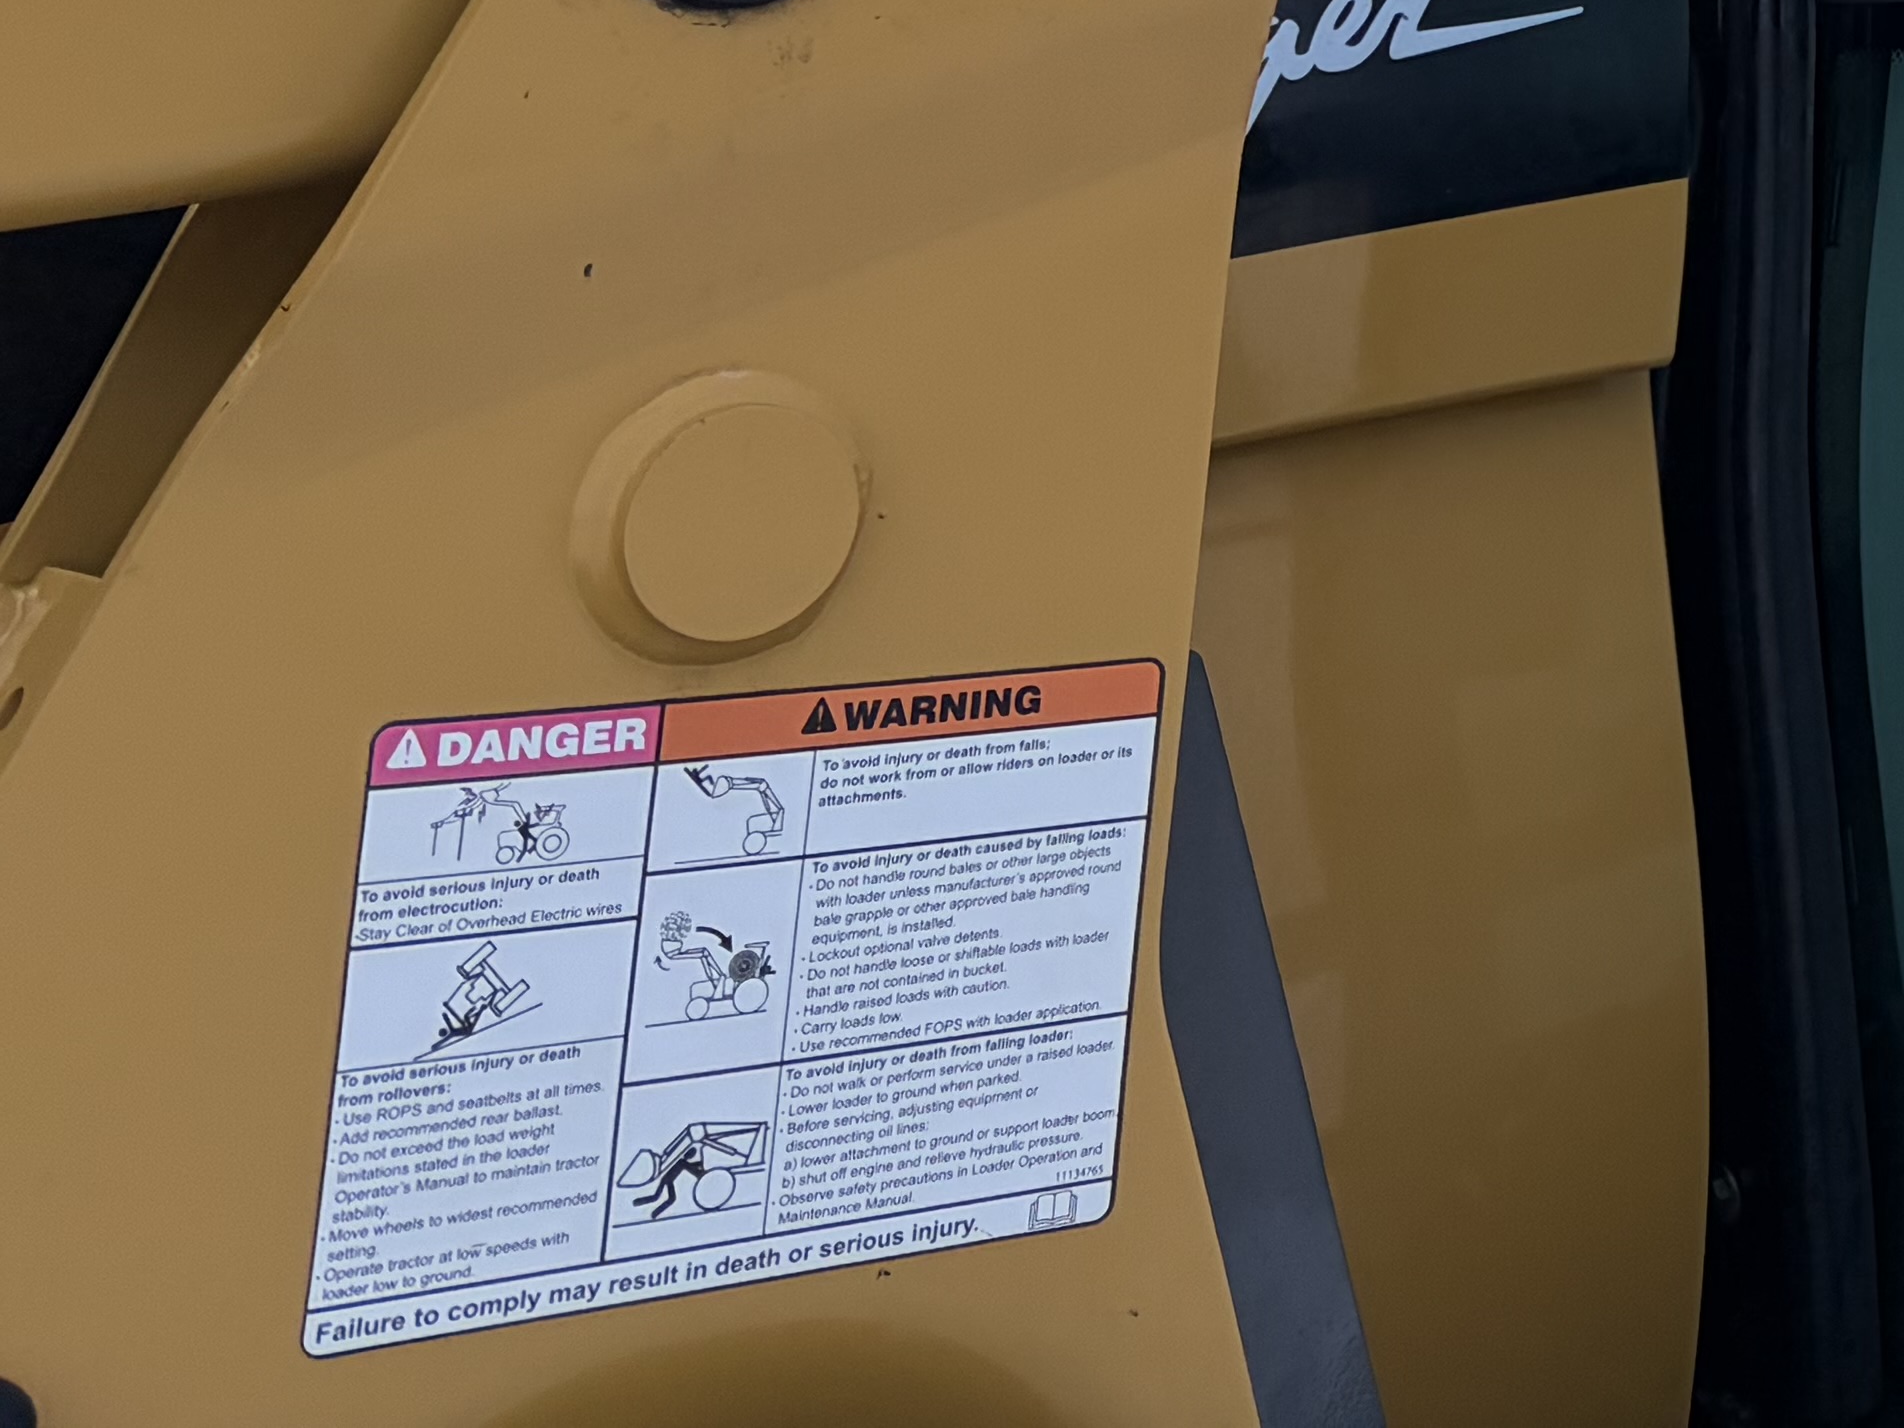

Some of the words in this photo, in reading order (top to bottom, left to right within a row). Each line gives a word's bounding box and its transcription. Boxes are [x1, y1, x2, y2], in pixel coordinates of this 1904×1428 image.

[842, 684, 1043, 733] WARNING
[436, 717, 647, 769] DANGER
[822, 759, 840, 772] To
[841, 754, 881, 770] avoid
[884, 751, 924, 768] injury
[926, 750, 941, 762] or
[944, 744, 982, 760] death
[985, 743, 1016, 756] from
[819, 776, 839, 790] do
[841, 773, 865, 788] not
[868, 769, 902, 785] work
[905, 767, 937, 781] from
[940, 766, 956, 777] or
[957, 762, 994, 776] allow
[996, 757, 1034, 772] riders
[1037, 756, 1055, 767] on
[1057, 750, 1098, 765] loader
[1100, 749, 1115, 760] or
[1117, 746, 1133, 759] its
[812, 861, 829, 874] To
[832, 855, 872, 872] avoid
[874, 852, 914, 869] injury
[916, 850, 932, 862] or
[934, 844, 972, 860] death
[975, 837, 1024, 855] caused
[1025, 836, 1043, 851] by
[1045, 832, 1086, 847] falling
[1087, 826, 1127, 842] loads:
[815, 878, 836, 892] Do
[837, 874, 860, 889] not
[862, 869, 906, 886] handle
[908, 863, 947, 880] round
[948, 861, 982, 876] bales
[985, 859, 999, 871] or
[1001, 855, 1034, 869] other
[1036, 851, 1067, 866] large
[1069, 845, 1112, 862] objects
[360, 889, 379, 903] To
[382, 884, 426, 902] avoid
[428, 880, 486, 897] serious
[490, 875, 535, 893] injury
[537, 874, 555, 886] or
[558, 867, 600, 884] death
[813, 912, 842, 927] bale
[844, 906, 894, 927] grapple
[896, 905, 911, 917] or
[912, 900, 947, 915] other
[948, 891, 1008, 912] approved
[1010, 888, 1037, 903] bale
[1039, 882, 1091, 899] handling
[815, 895, 843, 909] with
[844, 890, 887, 906] loader
[889, 885, 931, 901] unless
[933, 872, 1026, 895] manufacturer's
[1028, 863, 1086, 885] approved
[1087, 859, 1122, 876] round
[357, 927, 392, 949] Stay
[395, 923, 435, 938] Clear
[437, 918, 454, 934] of
[455, 911, 527, 932] Overhead
[530, 906, 583, 924] Electric
[585, 902, 623, 917] wires
[358, 909, 394, 923] from
[397, 897, 504, 919] electrocution:
[886, 923, 898, 936] is
[806, 967, 827, 982] Do
[829, 963, 851, 978] not
[853, 958, 898, 975] handle
[900, 955, 935, 969] loose
[937, 952, 952, 964] or
[954, 943, 1007, 962] shiftable
[1009, 938, 1042, 954] loads
[1045, 935, 1070, 949] with
[1072, 930, 1110, 946] loader
[808, 944, 861, 964] Lockout
[863, 937, 915, 958] optional
[917, 934, 951, 949] valve
[803, 1000, 850, 1018] Handle
[852, 993, 893, 1010] raised
[895, 988, 930, 1005] loads
[933, 985, 959, 999] with
[806, 984, 831, 1000] that
[834, 983, 856, 996] are
[858, 977, 880, 992] not
[882, 968, 945, 989] contained
[947, 968, 960, 979] in
[799, 1039, 826, 1054] Use
[828, 1024, 922, 1049] recommended
[924, 1017, 963, 1036] FOPS
[965, 1015, 991, 1030] with
[994, 1009, 1033, 1025] loader
[800, 1021, 838, 1036] Carry
[840, 1014, 876, 1030] loads
[340, 1073, 359, 1089] To
[362, 1067, 406, 1086] avoid
[408, 1057, 468, 1080] serious
[470, 1051, 515, 1073] injury
[518, 1053, 535, 1066] or
[538, 1042, 582, 1063] death
[785, 1067, 803, 1082] To
[805, 1060, 845, 1079] avoid
[847, 1057, 888, 1074] injury
[890, 1054, 906, 1066] or
[908, 1046, 947, 1064] death
[950, 1043, 982, 1058] from
[985, 1036, 1026, 1052] falling
[1028, 1029, 1073, 1046] loader:
[337, 1093, 374, 1108] from
[788, 1101, 829, 1118] Lower
[831, 1094, 873, 1110] loader
[876, 1091, 889, 1104] to
[891, 1082, 937, 1105] ground
[939, 1079, 974, 1094] when
[315, 1315, 406, 1345] Failure
[414, 1308, 440, 1328] to
[447, 1289, 542, 1322] comply
[548, 1281, 602, 1305] may
[608, 1265, 679, 1295] result
[685, 1261, 708, 1282] in
[714, 1247, 781, 1277] death
[787, 1245, 814, 1264] or
[818, 1230, 905, 1259] serious
